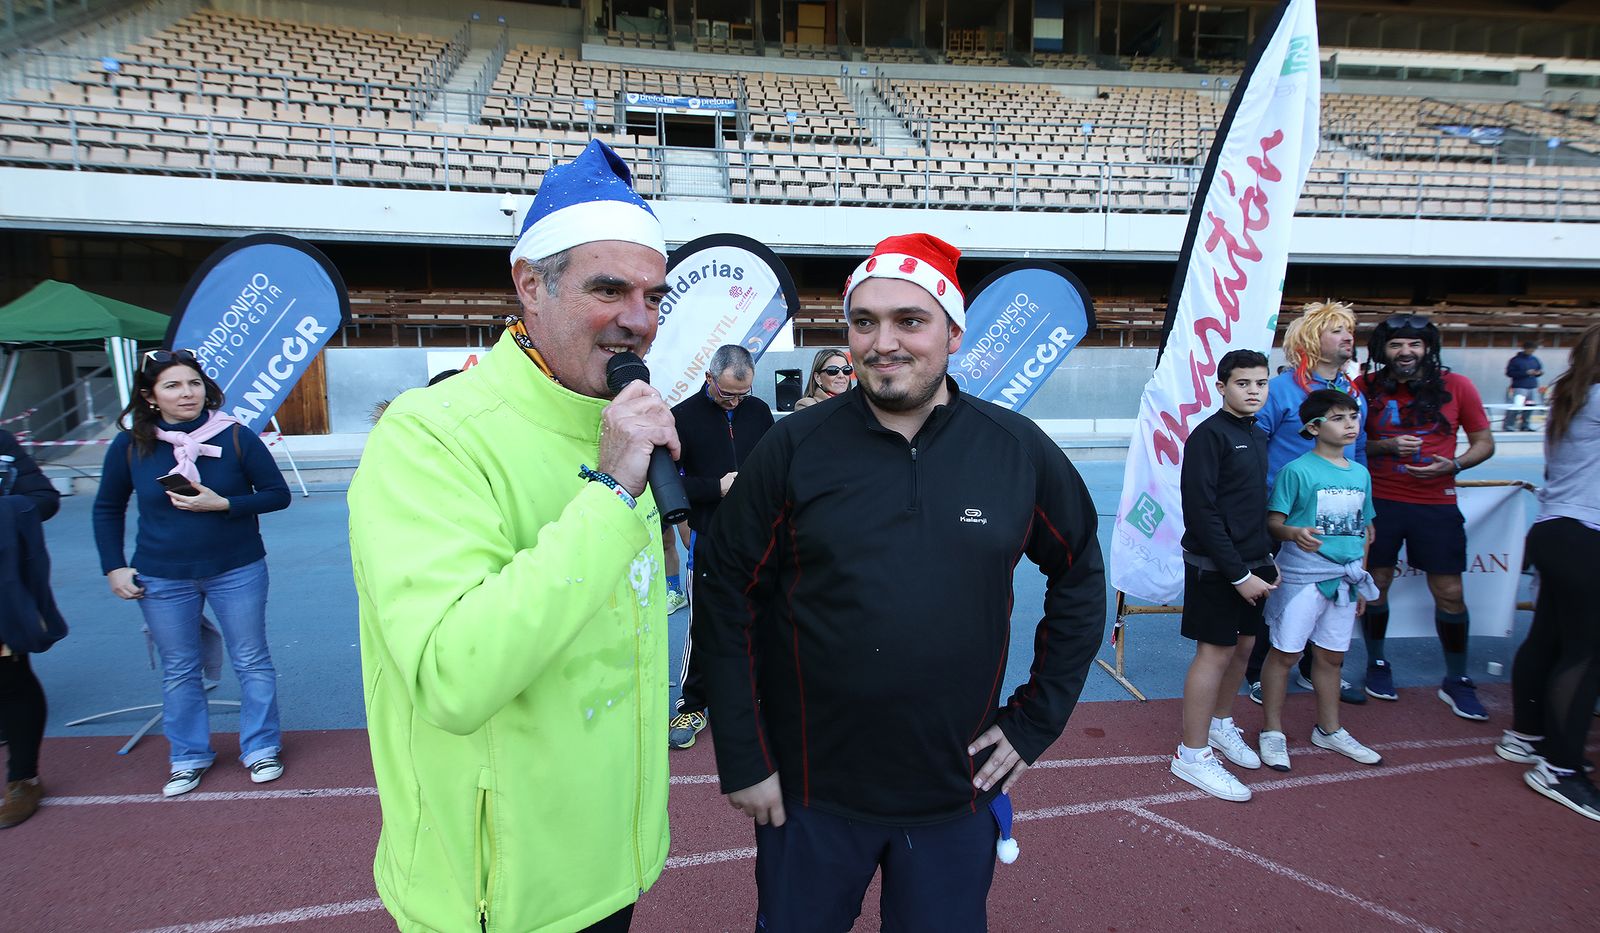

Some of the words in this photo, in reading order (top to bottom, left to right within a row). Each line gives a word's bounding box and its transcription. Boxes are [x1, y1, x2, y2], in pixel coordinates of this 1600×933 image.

[196, 273, 269, 370] SANDIONISIO
[658, 259, 745, 326] solidarias
[206, 284, 283, 379] ORTOPEDIA
[683, 314, 738, 381] INFANTIL
[960, 293, 1029, 372] SANDIONISIO
[971, 303, 1040, 379] ORTOPEDIA
